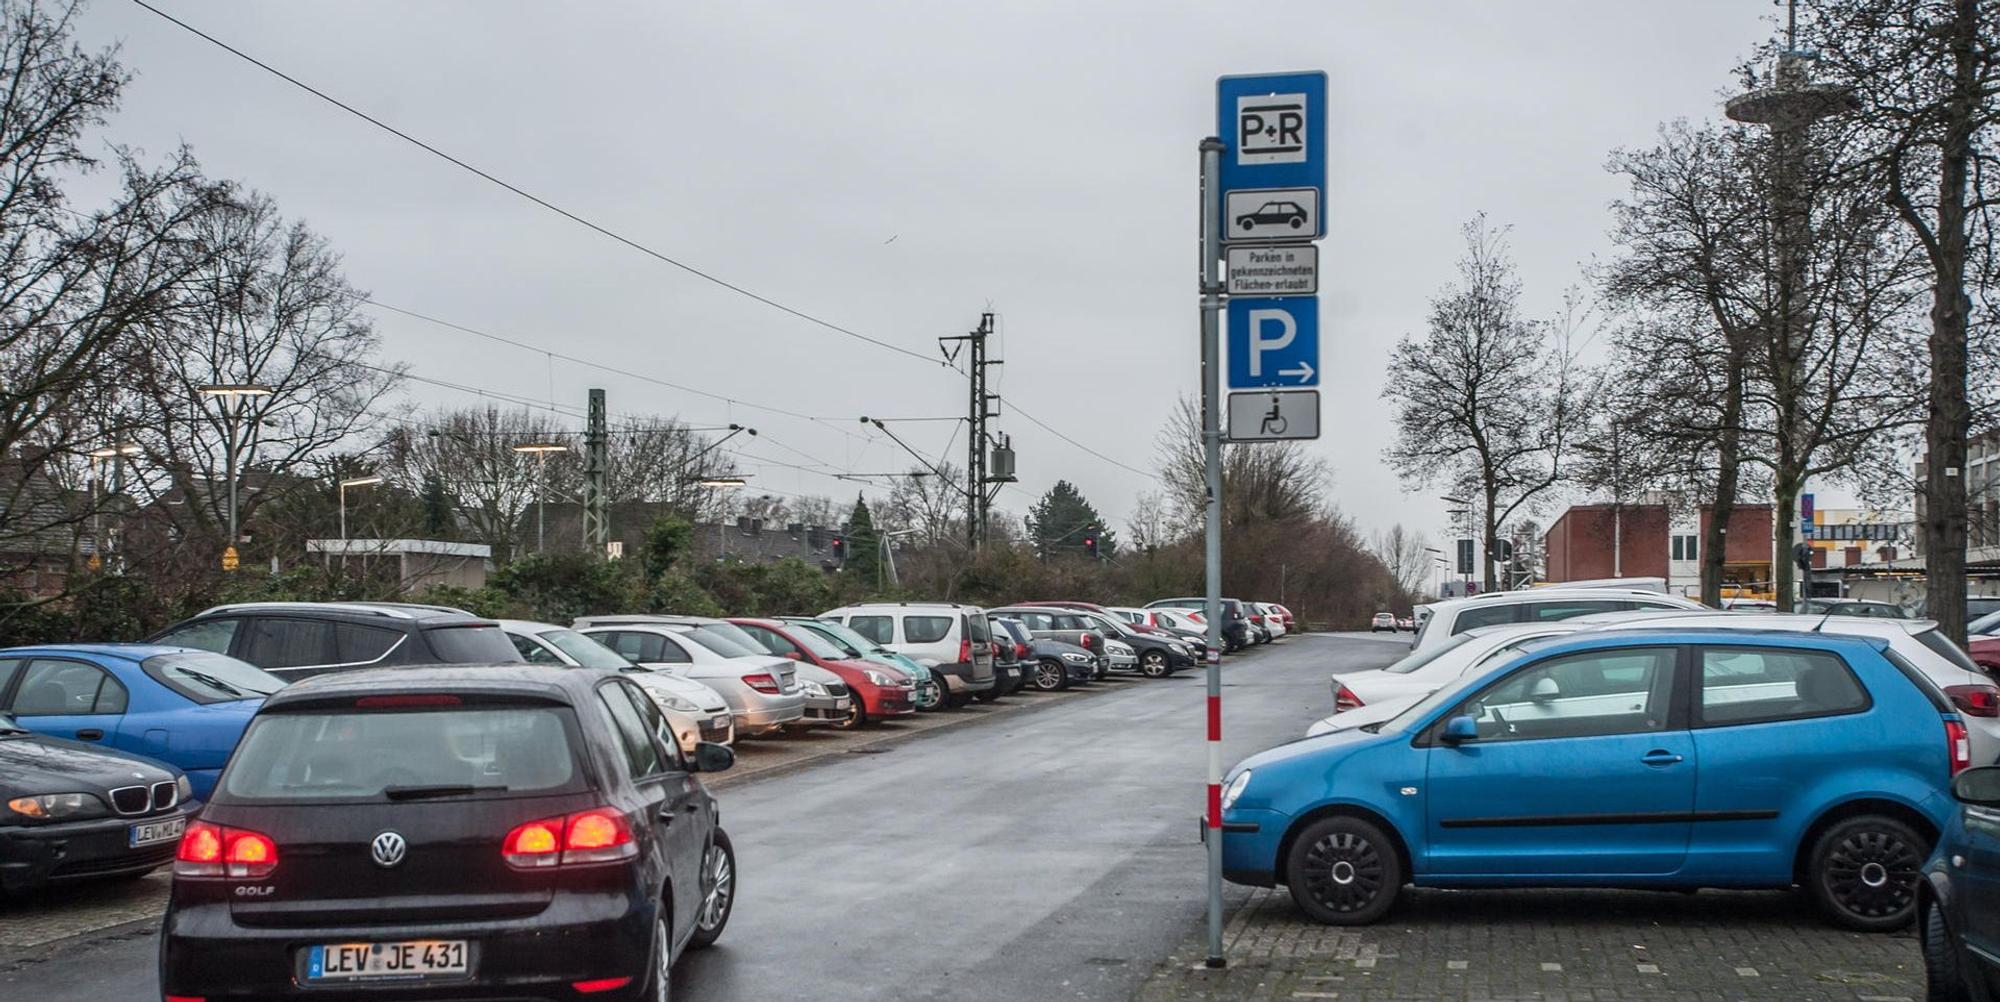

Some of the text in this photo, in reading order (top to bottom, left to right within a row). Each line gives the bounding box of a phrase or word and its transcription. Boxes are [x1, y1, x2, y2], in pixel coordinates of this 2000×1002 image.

[1241, 112, 1303, 147] P+R
[1249, 251, 1295, 263] Parken in
[1231, 265, 1313, 280] gekennzeichneten
[1274, 279, 1308, 289] erlaubt
[1249, 308, 1297, 376] P
[235, 886, 275, 896] GOLF
[324, 948, 369, 972] LEV
[386, 946, 415, 970] JE
[422, 944, 464, 968] 431
